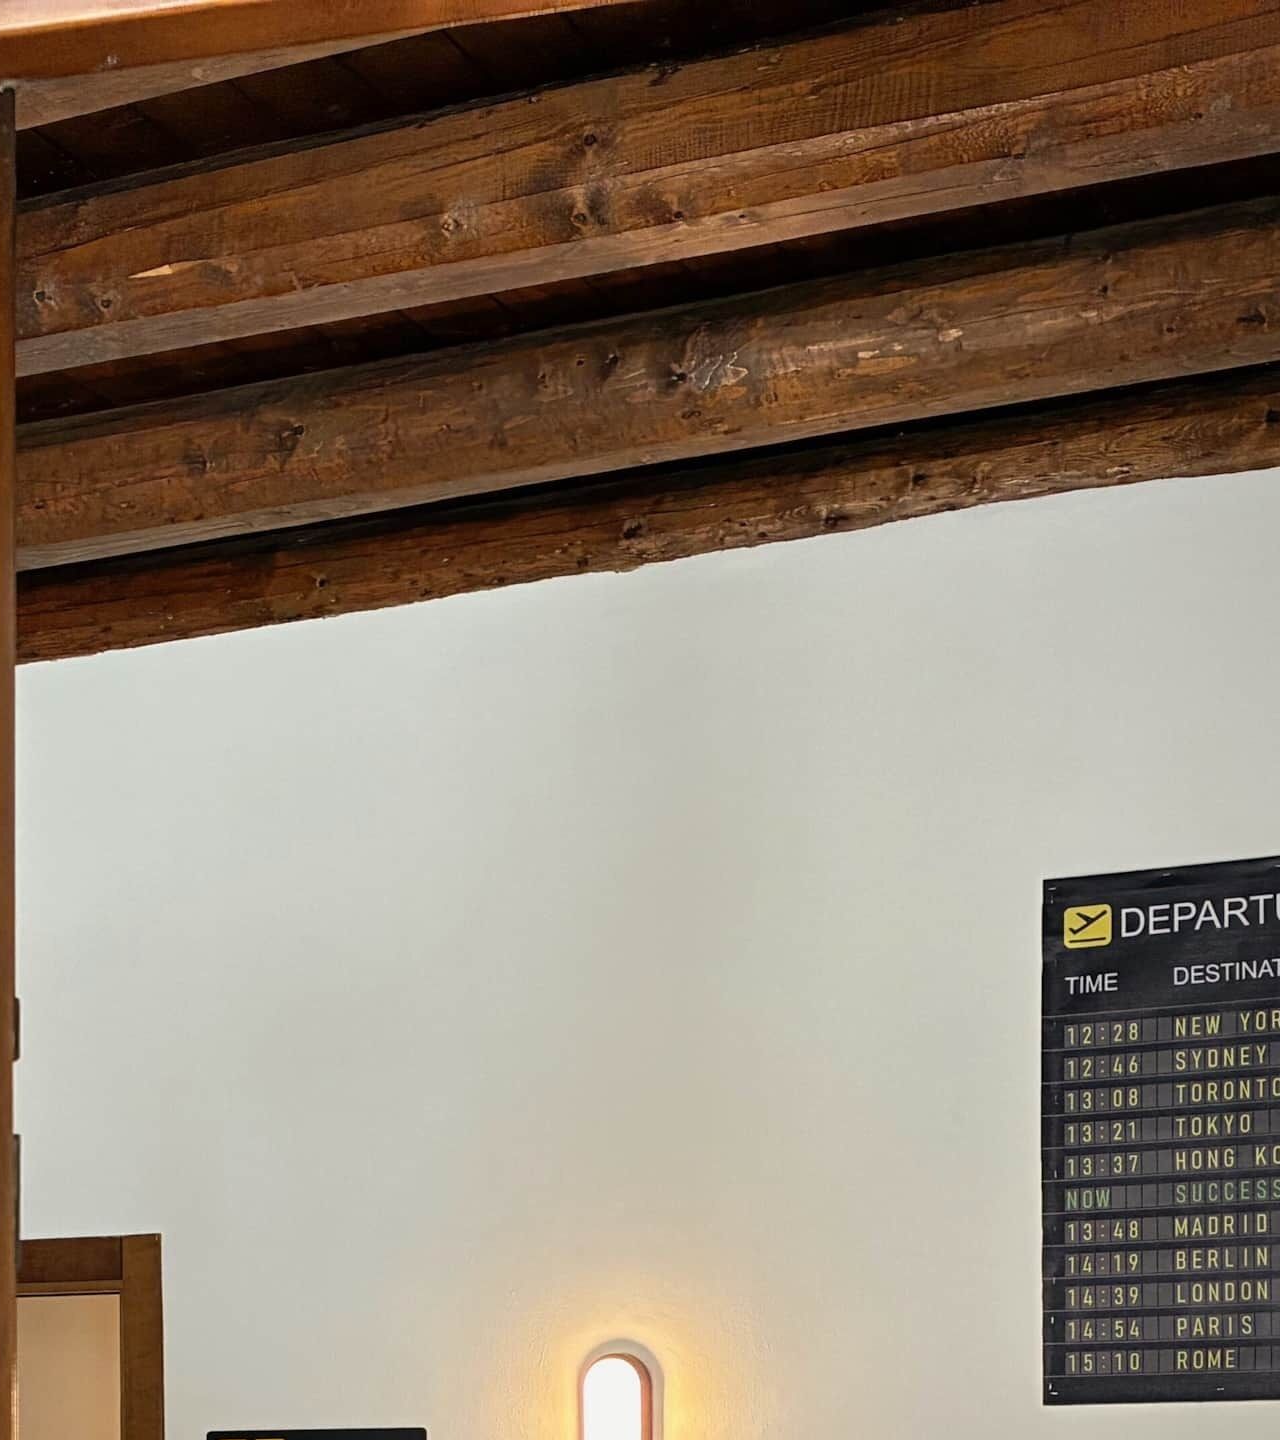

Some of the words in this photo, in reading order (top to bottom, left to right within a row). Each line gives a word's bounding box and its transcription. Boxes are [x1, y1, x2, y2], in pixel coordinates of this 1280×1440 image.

[1065, 973, 1118, 994] TIME
[1067, 1023, 1138, 1045] 12:28
[1175, 1015, 1220, 1037] NEW
[1067, 1056, 1138, 1078] 12:46
[1175, 1046, 1267, 1070] SYDNEY
[1068, 1089, 1138, 1110] 13:08
[1068, 1122, 1137, 1143] 13:21
[1176, 1114, 1251, 1137] TOKYO
[1068, 1155, 1138, 1176] 13:37
[1176, 1148, 1234, 1170] HONG
[1067, 1189, 1111, 1209] NOW
[1068, 1220, 1138, 1241] 13:48
[1175, 1214, 1267, 1236] MADRID
[1068, 1254, 1138, 1274] 14:19
[1176, 1248, 1268, 1269] BERLIN
[1068, 1287, 1138, 1306] 14:39
[1177, 1281, 1268, 1303] LONDON
[1068, 1320, 1140, 1339] 14:54
[1177, 1316, 1252, 1336] PARIS
[1068, 1353, 1140, 1372] 15:10
[1177, 1350, 1236, 1369] ROME
